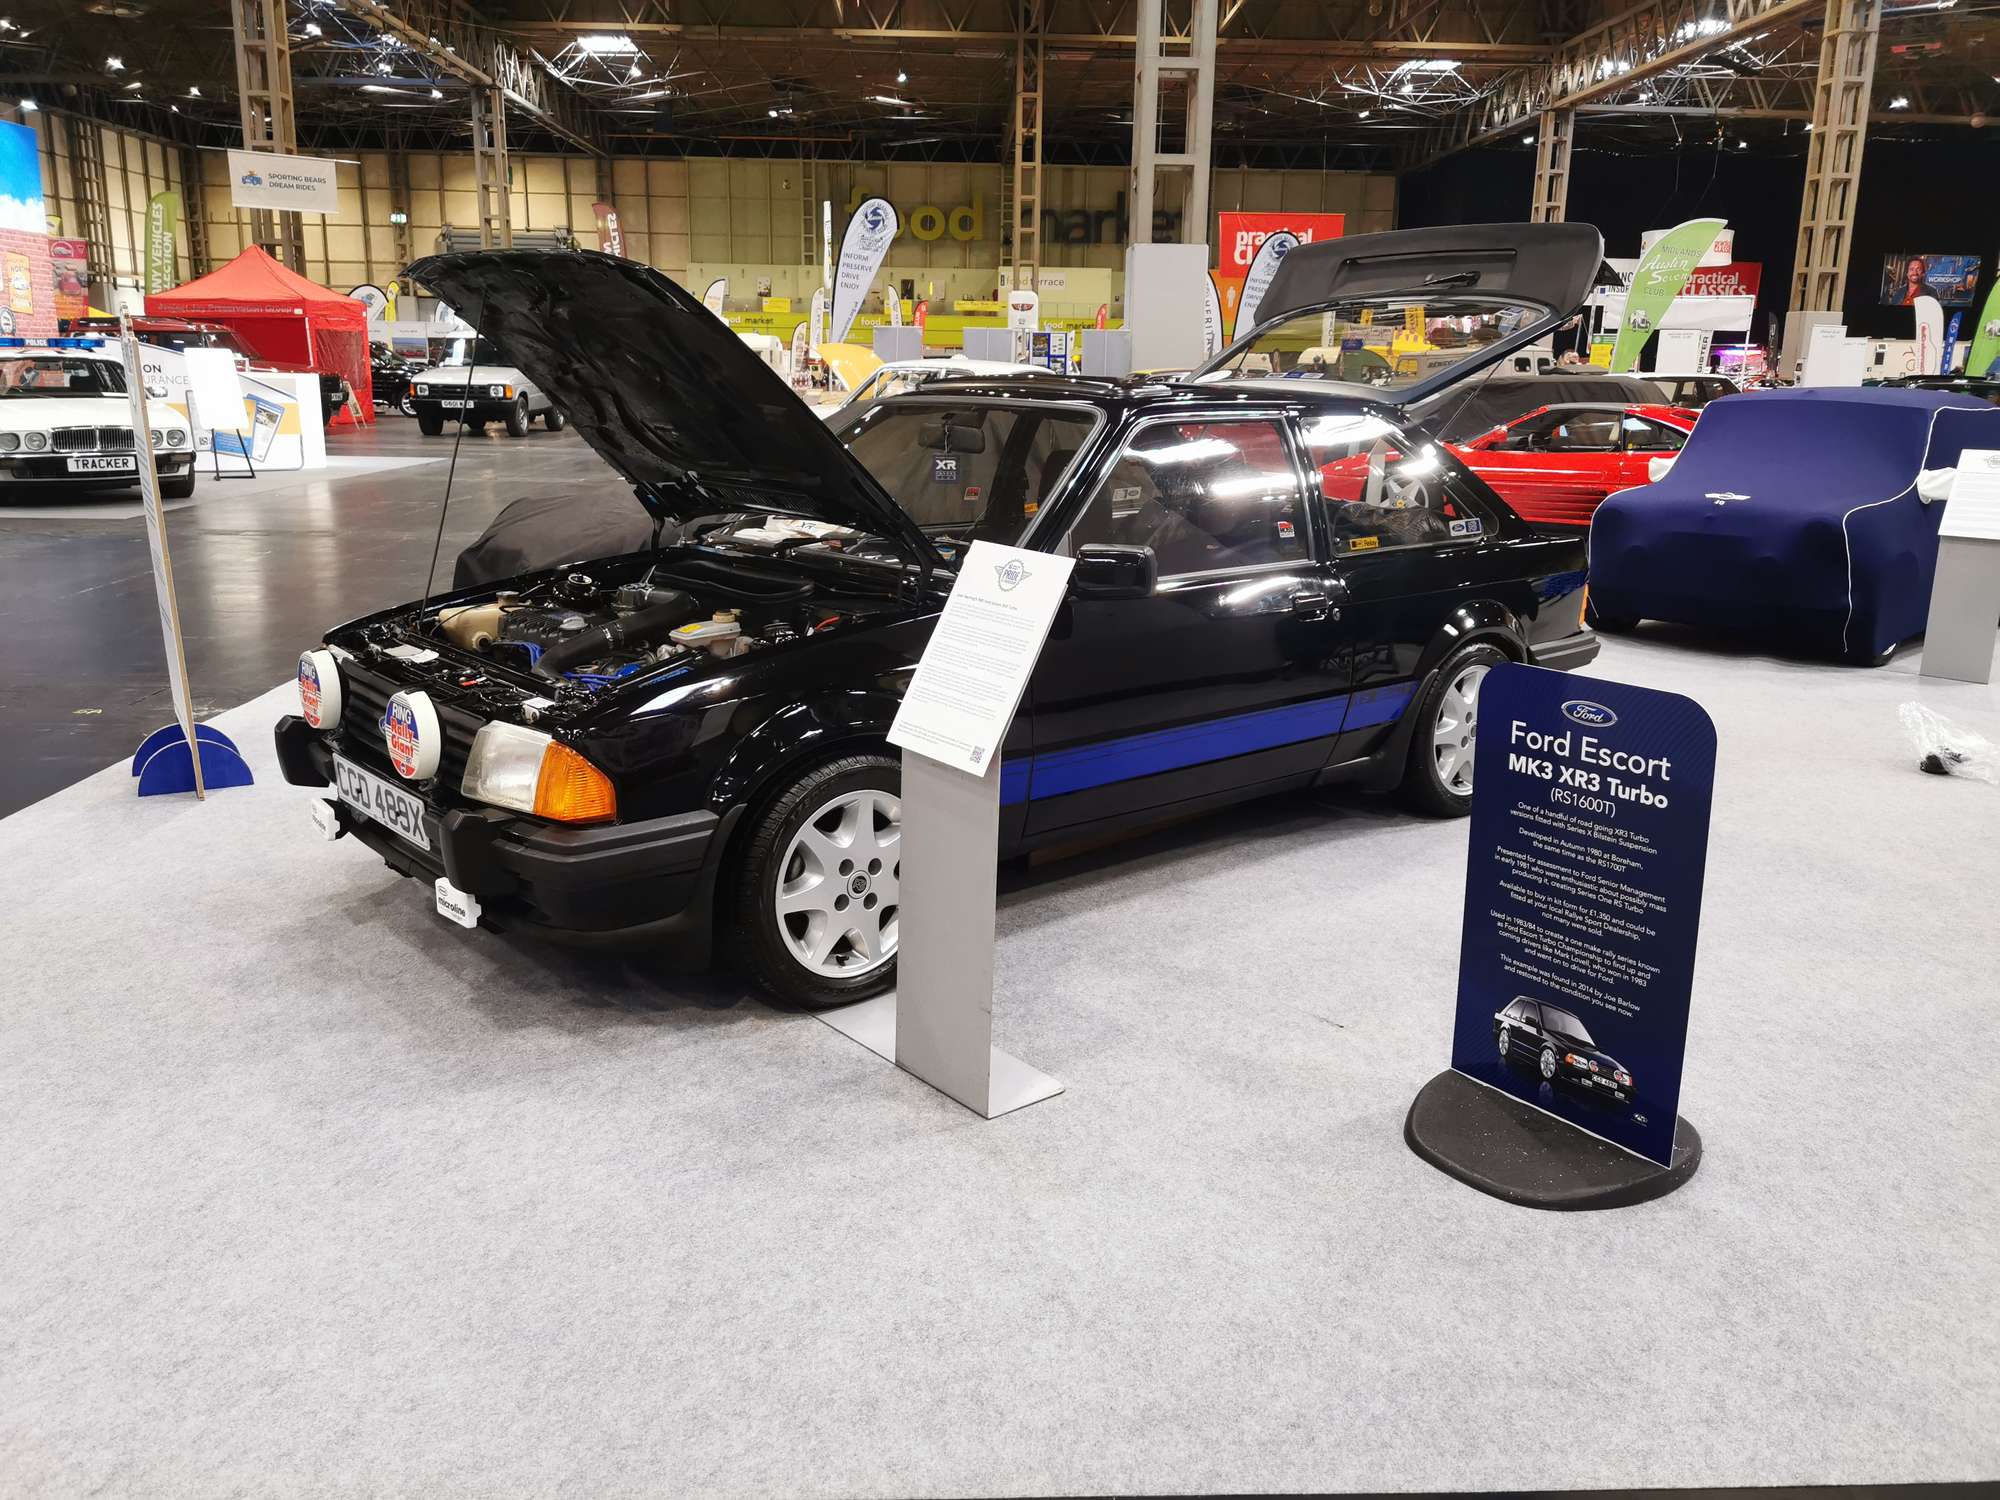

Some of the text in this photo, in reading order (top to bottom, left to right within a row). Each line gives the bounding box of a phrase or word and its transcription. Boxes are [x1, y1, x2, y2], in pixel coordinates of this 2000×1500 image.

[268, 173, 327, 184] SPORTING BEARS
[269, 182, 295, 190] DREAM
[152, 202, 164, 267] VEHICLES
[842, 262, 873, 272] PRESERVE
[843, 252, 869, 262] INFORM
[840, 282, 860, 290] ENJOY
[841, 272, 860, 280] DRIVE
[1043, 320, 1063, 329] food
[25, 338, 48, 346] POLICE
[74, 458, 129, 469] TRACKER
[935, 459, 957, 470] XR
[301, 661, 317, 679] RING
[390, 716, 414, 744] Rally
[392, 702, 412, 724] RING
[1573, 705, 1604, 722] Ford
[391, 734, 414, 758] Giant
[1510, 720, 1672, 782] Ford Escort
[1508, 752, 1668, 808] MK3 XR3 Turbo
[375, 784, 425, 843] 489X
[1550, 786, 1616, 818] (RS1600T)
[1509, 808, 1658, 855] versions fitted with Series Bilstein Suspension
[1517, 800, 1650, 844] One handful road going XR3 Turbo
[1517, 826, 1644, 871] Developed Autumn 1980 Boreham,
[1531, 838, 1627, 873] the same time the RS1700T
[1496, 844, 1666, 904] Presented assessment Ford Senior Management
[1500, 856, 1667, 913] early 1981 who were enthusiastic about possibly mass
[1511, 864, 1644, 915] producing creating Series One Turbo
[437, 897, 466, 917] microline
[1498, 879, 1646, 933] Available buy kit form £1,350 could
[1509, 890, 1641, 942] fitted your local Rallye Sport Dealership,
[1540, 910, 1604, 937] not many were sold.
[1489, 908, 1661, 974] Used 1983/84 create one make rally series known
[1497, 929, 1647, 987] coming drivers like Mark Lovell, who won 1983
[1503, 921, 1626, 971] Ford Escort Turbo Championship find
[1499, 952, 1641, 1012] This example was found 2014 Joe Barlow
[1536, 951, 1615, 985] went drive Ford.
[1515, 968, 1633, 1018] restored the condition you see now.
